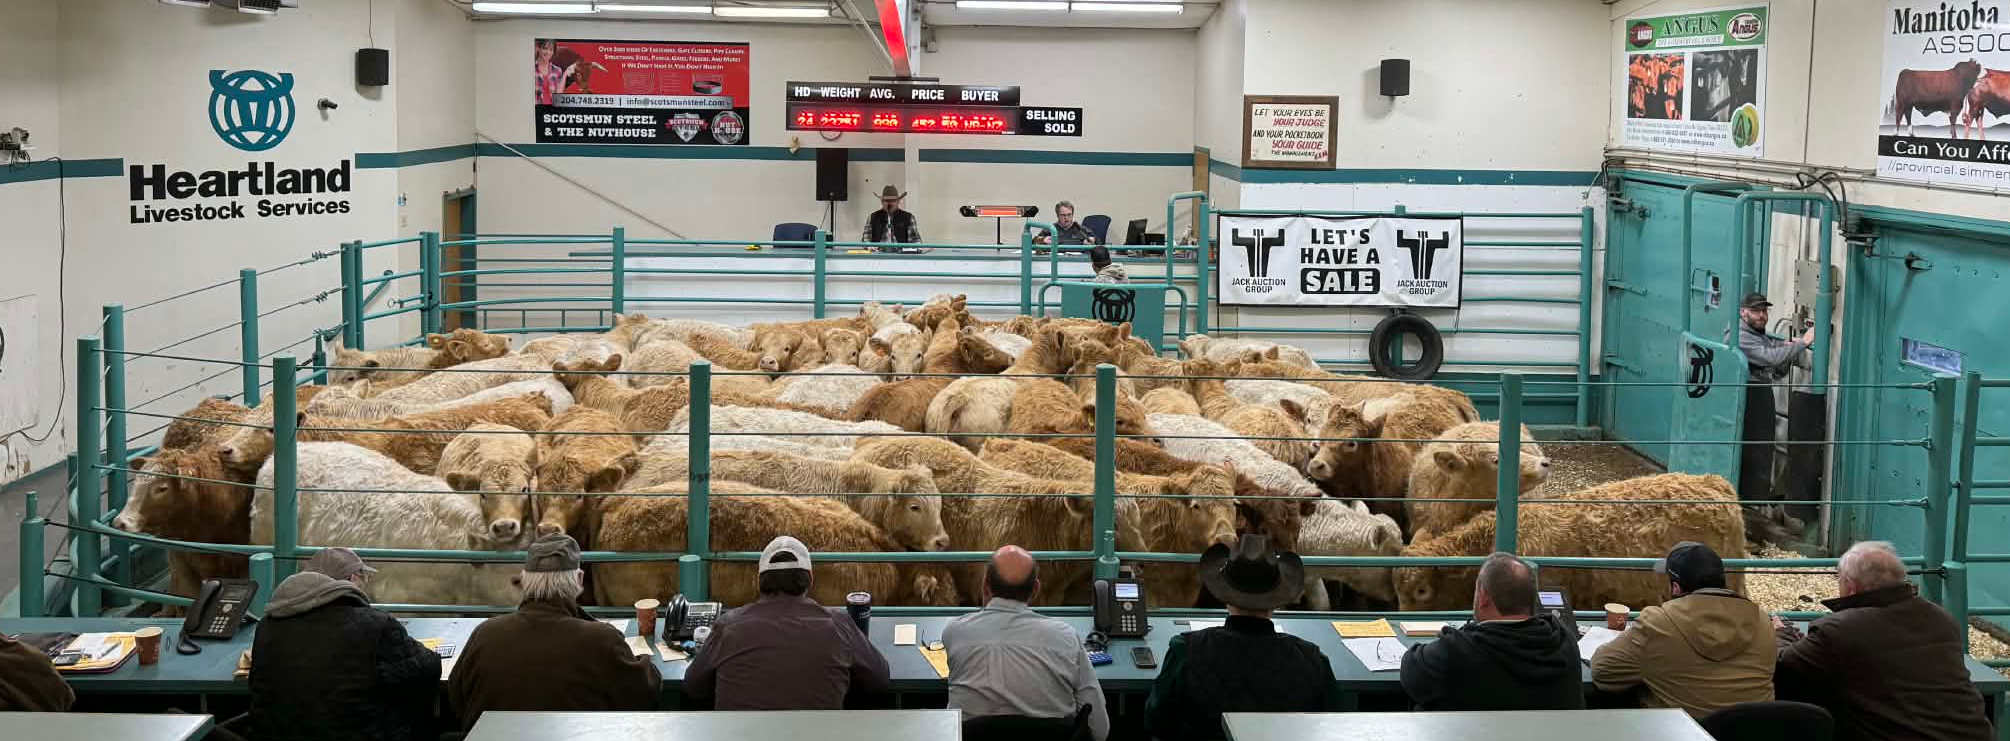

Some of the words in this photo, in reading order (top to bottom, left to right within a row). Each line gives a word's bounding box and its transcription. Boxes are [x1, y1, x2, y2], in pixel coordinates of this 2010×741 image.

[1892, 0, 1999, 35] Manitoba
[1661, 15, 1720, 36] ANGUS
[795, 86, 811, 97] HD
[820, 87, 861, 99] WEIGHT
[869, 88, 895, 99] AVG.
[912, 89, 945, 100] PRICE
[961, 90, 999, 101] BUYER
[560, 96, 614, 106] 204.748.2319
[1026, 110, 1076, 121] SELLING
[1254, 108, 1270, 116] LET
[1273, 109, 1293, 117] YOUR
[1293, 109, 1314, 117] EYES
[1315, 109, 1326, 117] BE
[543, 114, 613, 125] SCOTSMUN
[616, 114, 657, 125] STEEL
[1272, 118, 1295, 126] YOUR
[1295, 118, 1326, 127] JUDGE
[544, 127, 553, 136] &
[557, 127, 584, 137] THE
[587, 128, 656, 138] NUTHOUSE
[1044, 122, 1076, 133] SOLD
[1253, 129, 1265, 138] AND
[1266, 129, 1284, 138] YOUR
[1284, 130, 1324, 139] POCKETBOOK
[1272, 139, 1295, 149] YOUR
[1296, 140, 1324, 150] GUIDE
[1894, 140, 1928, 156] Can
[1936, 142, 1970, 158] You
[129, 160, 351, 201] Heartland
[130, 201, 244, 224] Livestock
[257, 198, 350, 217] Services
[1311, 228, 1370, 245] LET'S
[1300, 248, 1358, 265] HAVE
[1366, 248, 1380, 264] A
[1232, 278, 1251, 286] JACK
[1252, 278, 1286, 287] AUCTION
[1305, 270, 1374, 292] SALE
[1397, 279, 1416, 288] JACK
[1416, 280, 1448, 288] AUCTION
[1245, 285, 1273, 293] GROUP
[1409, 287, 1435, 295] GROUP
